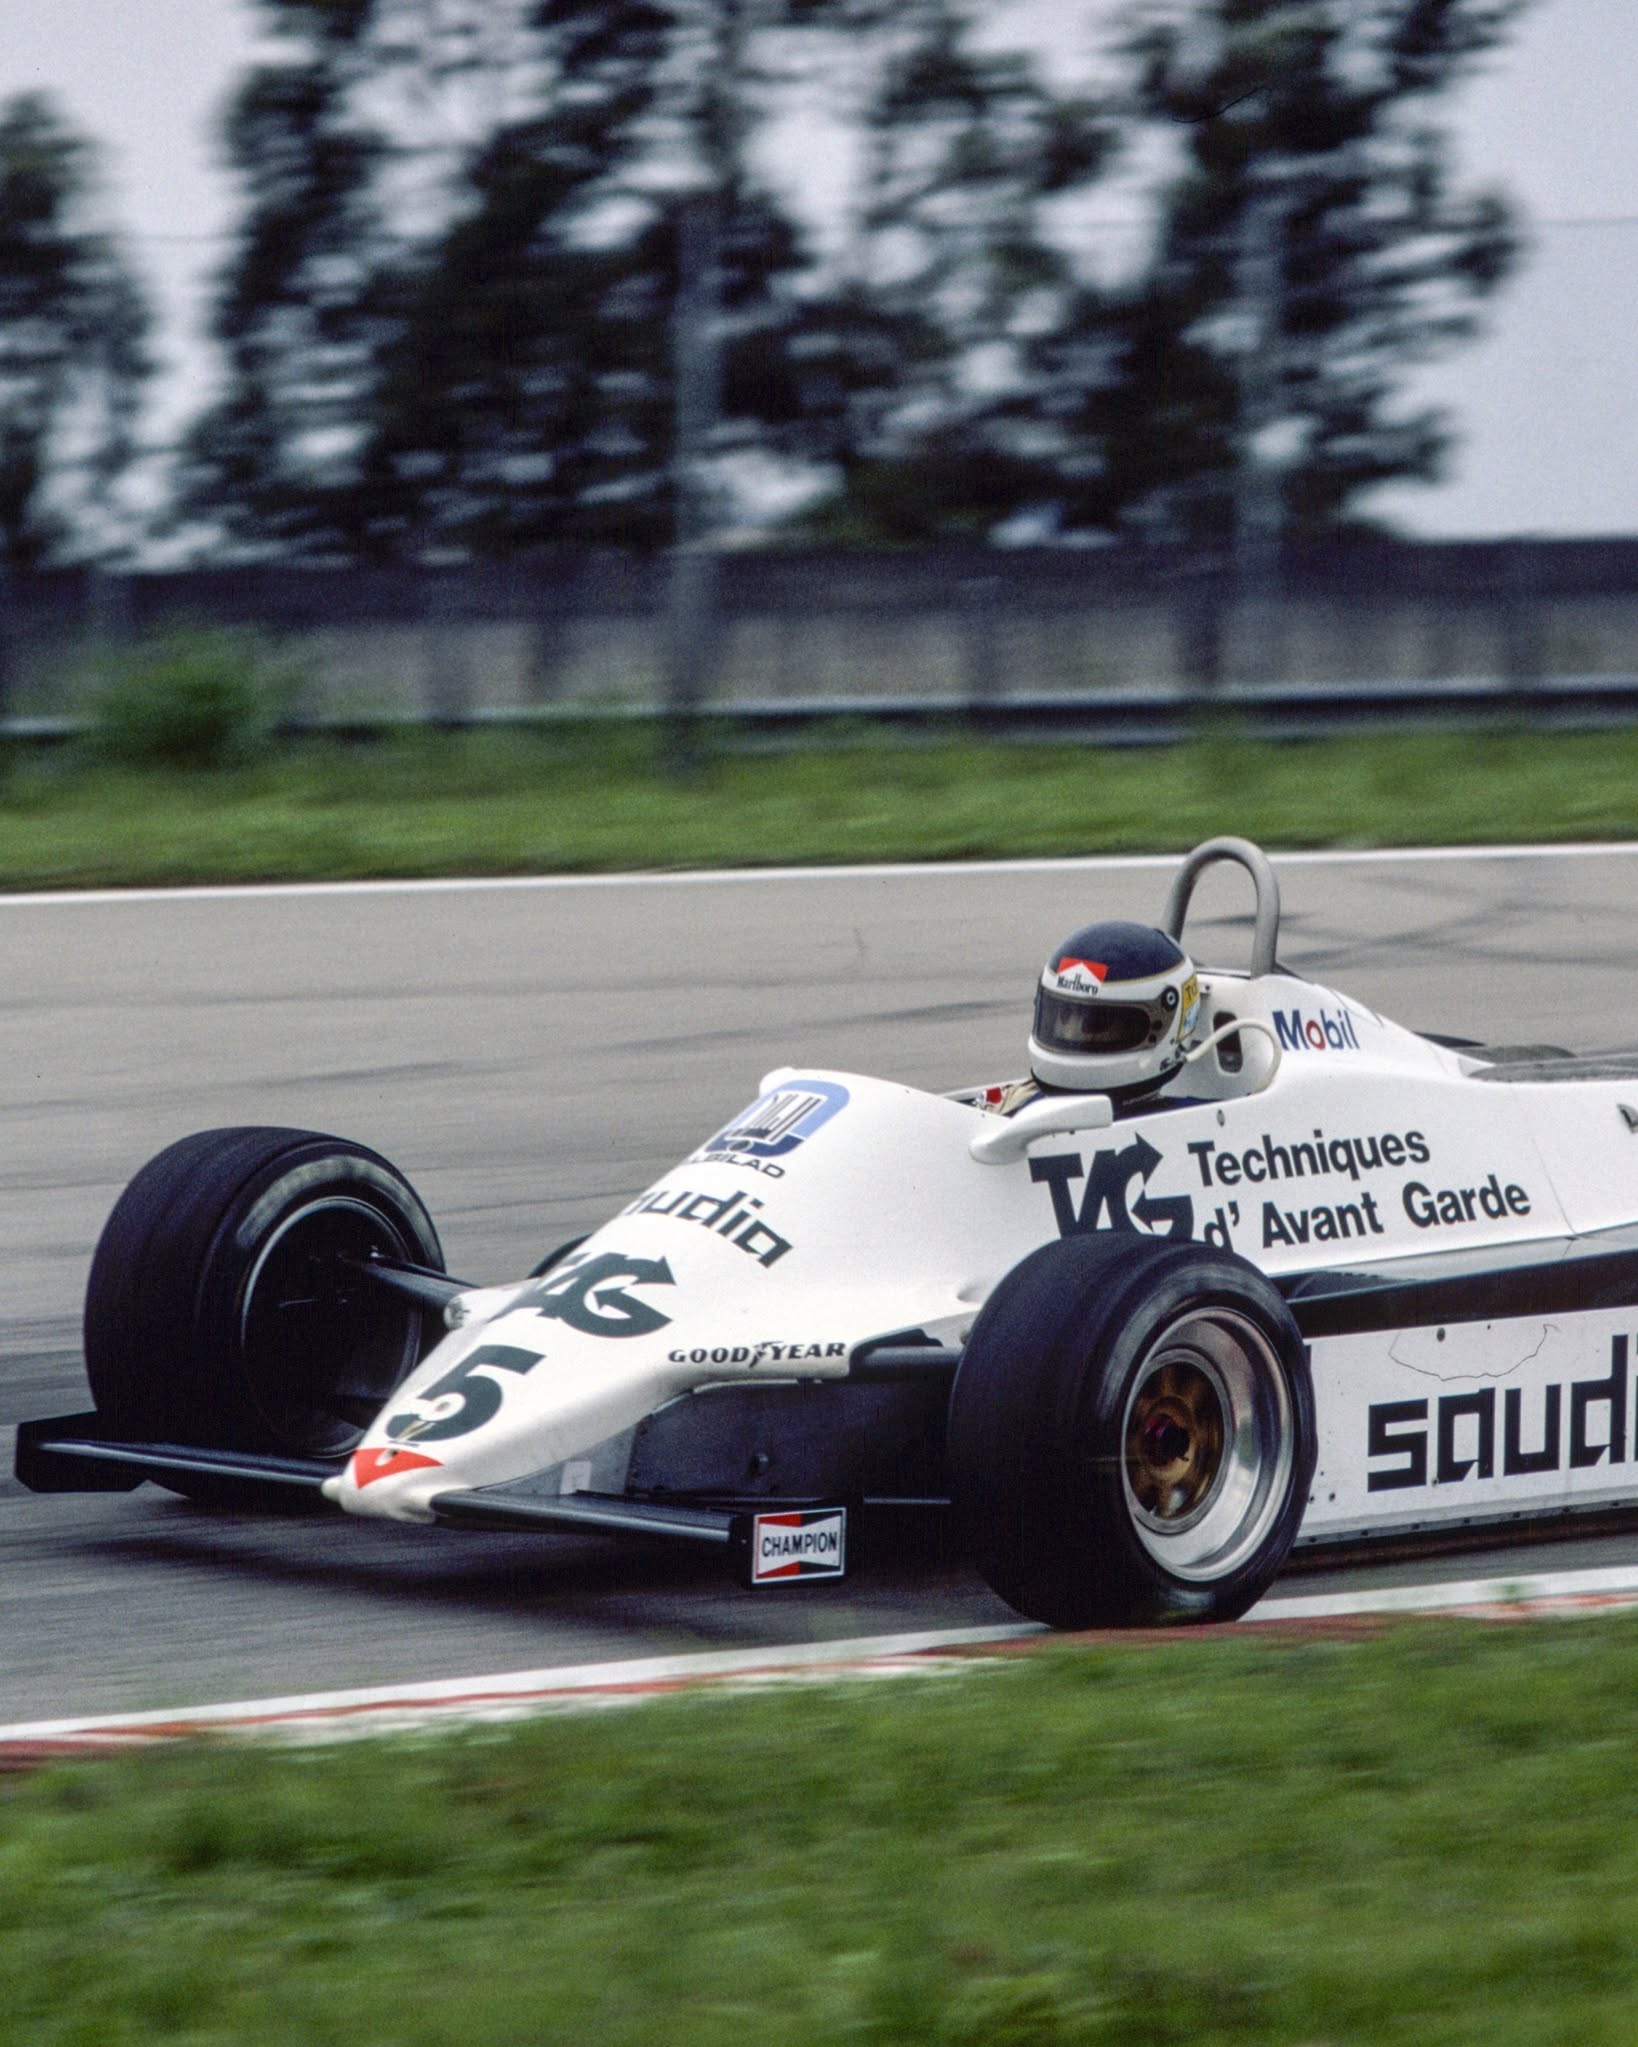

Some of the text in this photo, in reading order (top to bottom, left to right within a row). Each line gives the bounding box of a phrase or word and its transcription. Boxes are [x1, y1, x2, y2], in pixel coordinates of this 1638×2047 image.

[1056, 972, 1099, 996] Marlboro
[1272, 1009, 1360, 1051] Mobil
[1187, 1130, 1430, 1187] Techniques
[1262, 1192, 1384, 1249] Avant
[1402, 1174, 1532, 1229] Garde
[667, 1341, 847, 1368] GOODYEAR
[386, 1344, 547, 1443] 5
[1367, 1334, 1638, 1493] saud
[761, 1531, 839, 1558] CHAMPION
